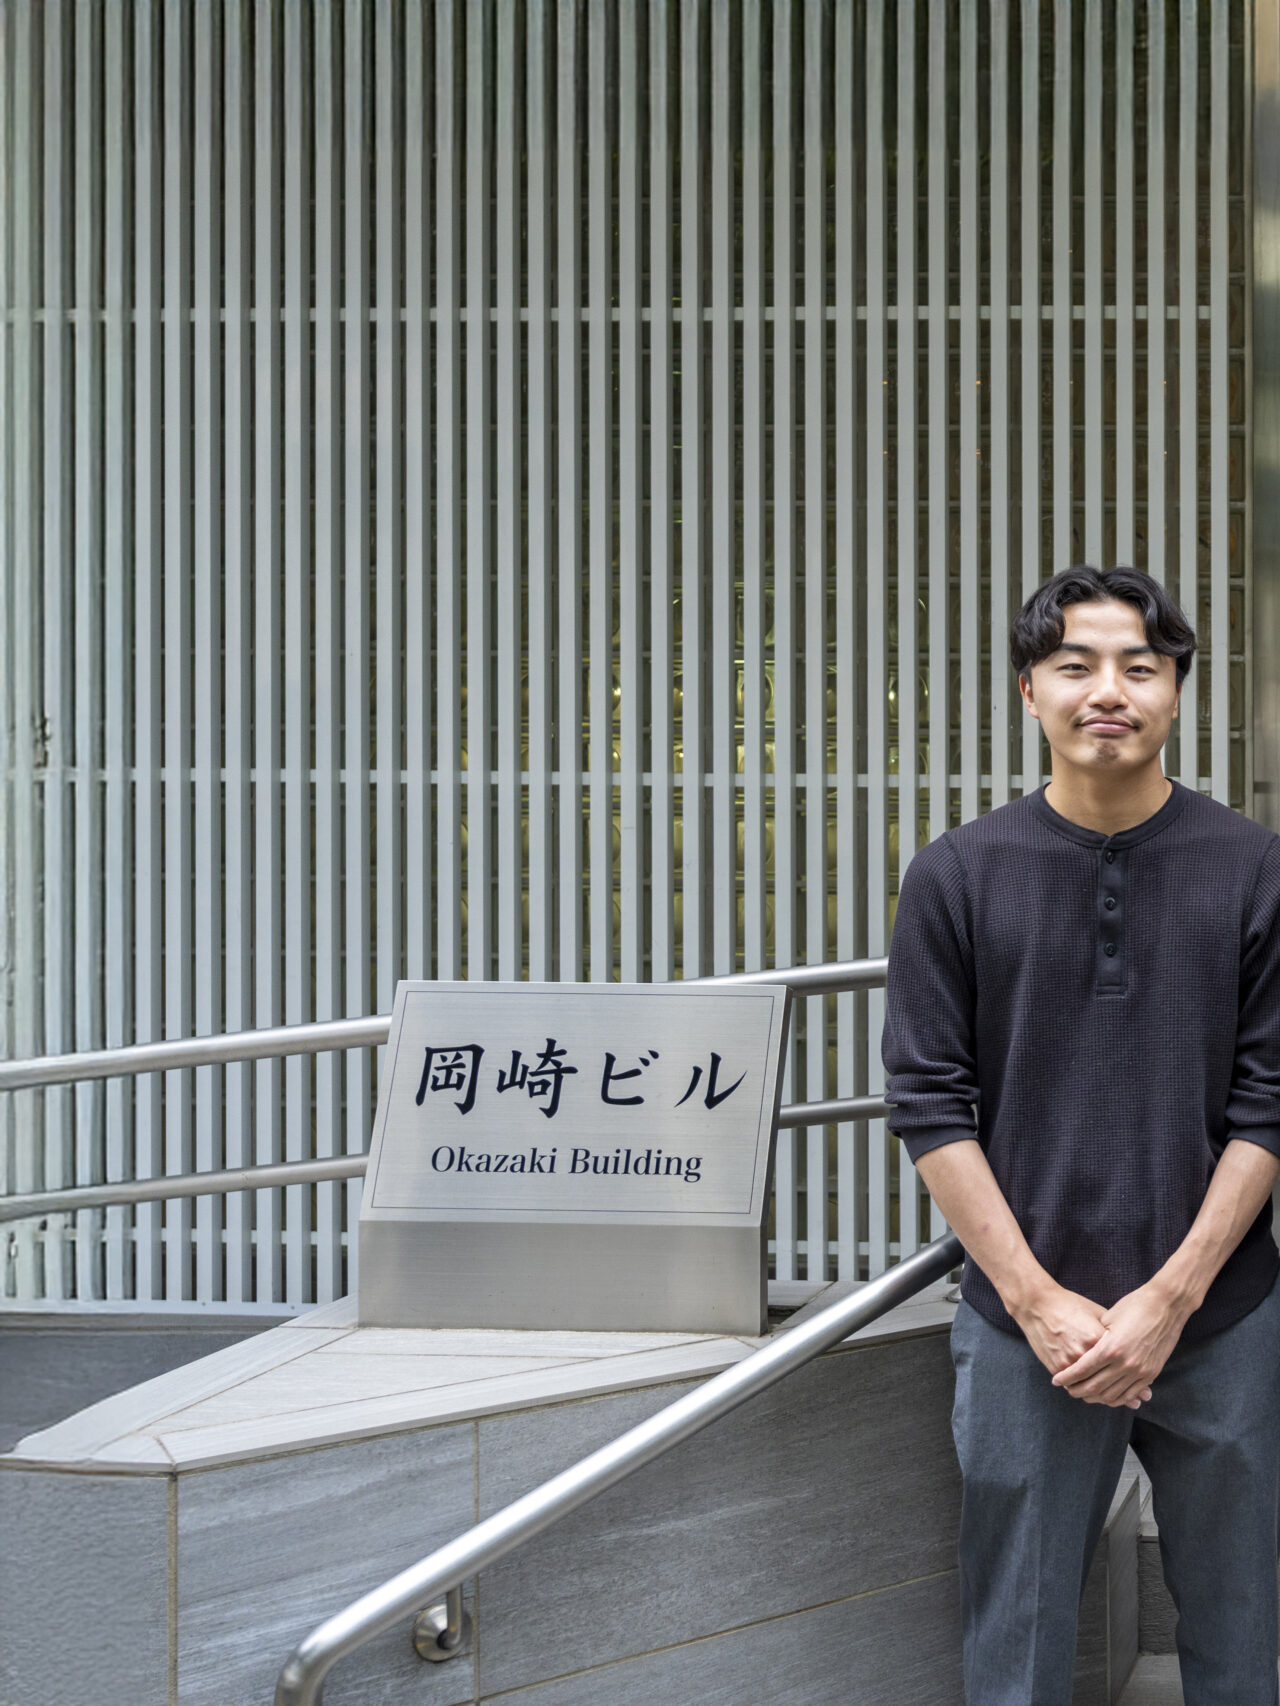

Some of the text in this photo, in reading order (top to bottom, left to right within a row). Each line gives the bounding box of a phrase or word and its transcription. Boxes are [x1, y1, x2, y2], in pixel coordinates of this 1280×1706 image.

[415, 1037, 747, 1119] 岡崎ビル
[431, 1146, 703, 1183] Okazaki Building
